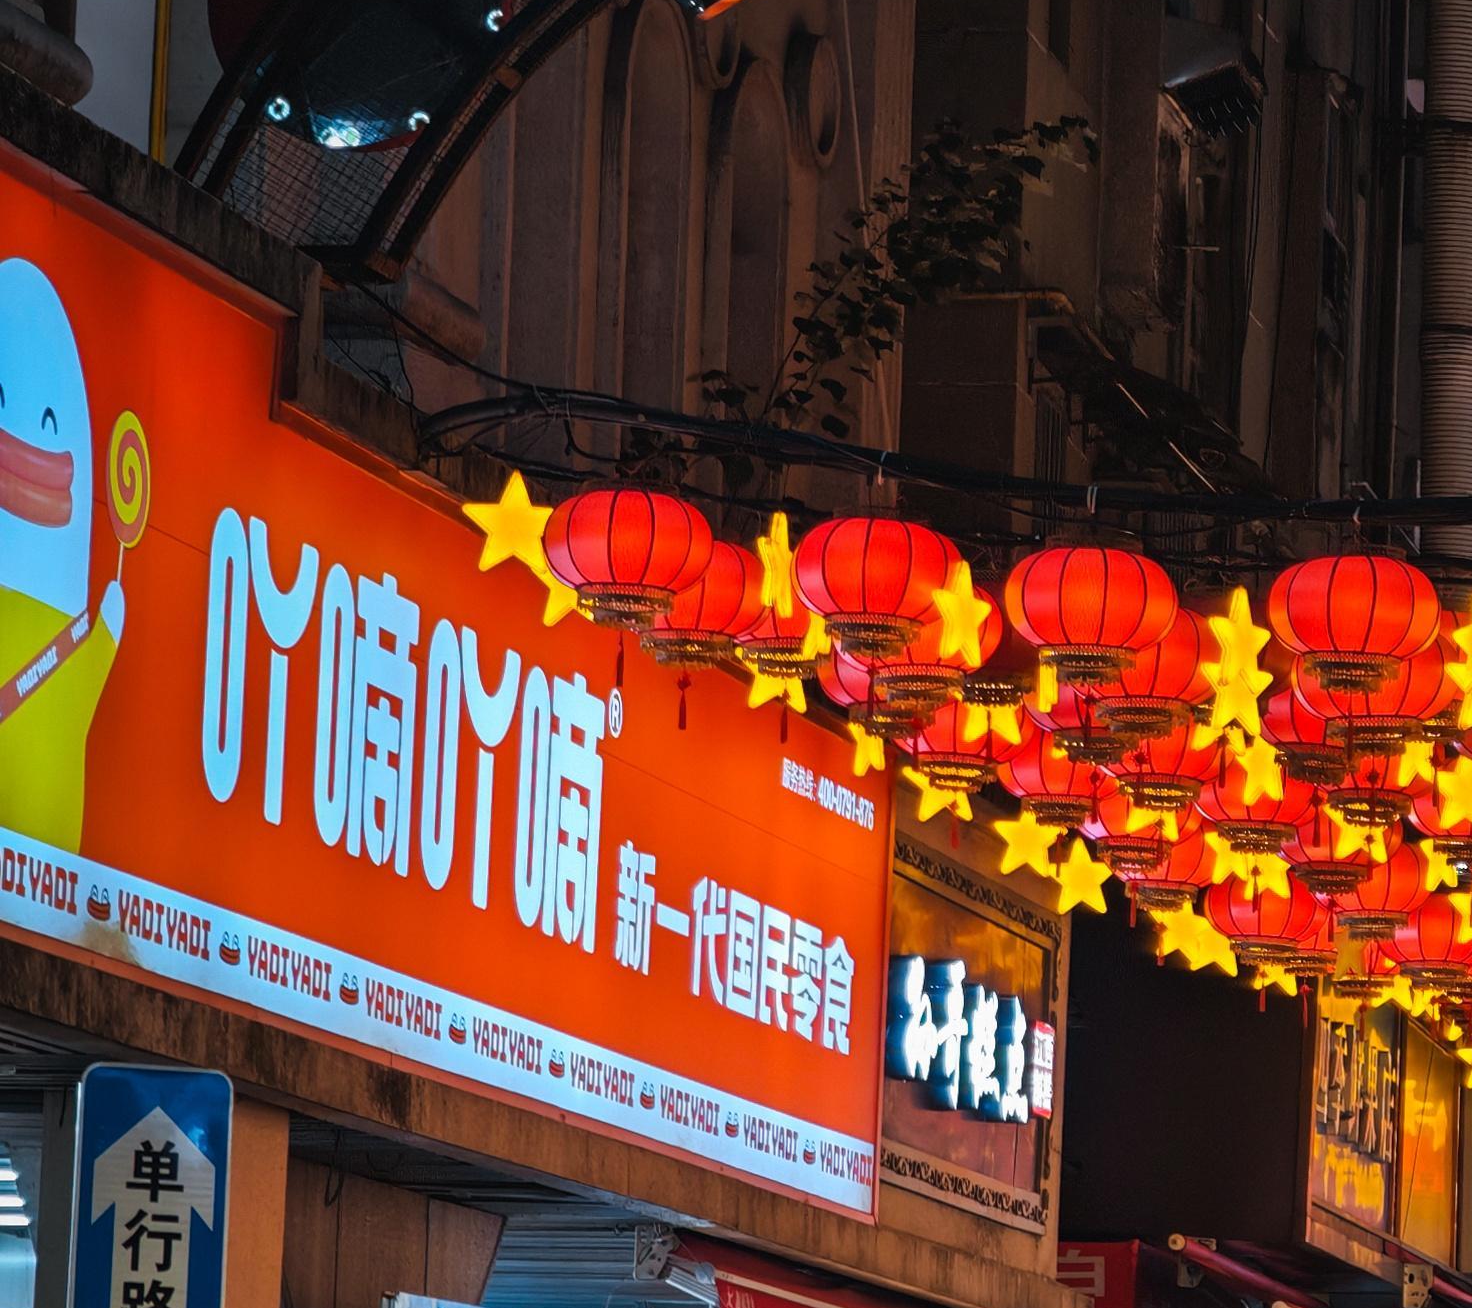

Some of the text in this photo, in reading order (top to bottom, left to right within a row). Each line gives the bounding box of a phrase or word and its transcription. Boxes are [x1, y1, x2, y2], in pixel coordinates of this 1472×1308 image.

[118, 889, 211, 960] YADIYADI
[247, 935, 332, 1002] YADIYADI
[366, 977, 443, 1040] YADIYADI
[473, 1017, 542, 1074] YADIYADI
[570, 1052, 634, 1107] YADIYADI
[660, 1085, 719, 1136] YADIYADI
[744, 1114, 799, 1162] YADIYADI
[820, 1141, 872, 1185] YADIYADI
[615, 839, 855, 1056] 新一代国民零食
